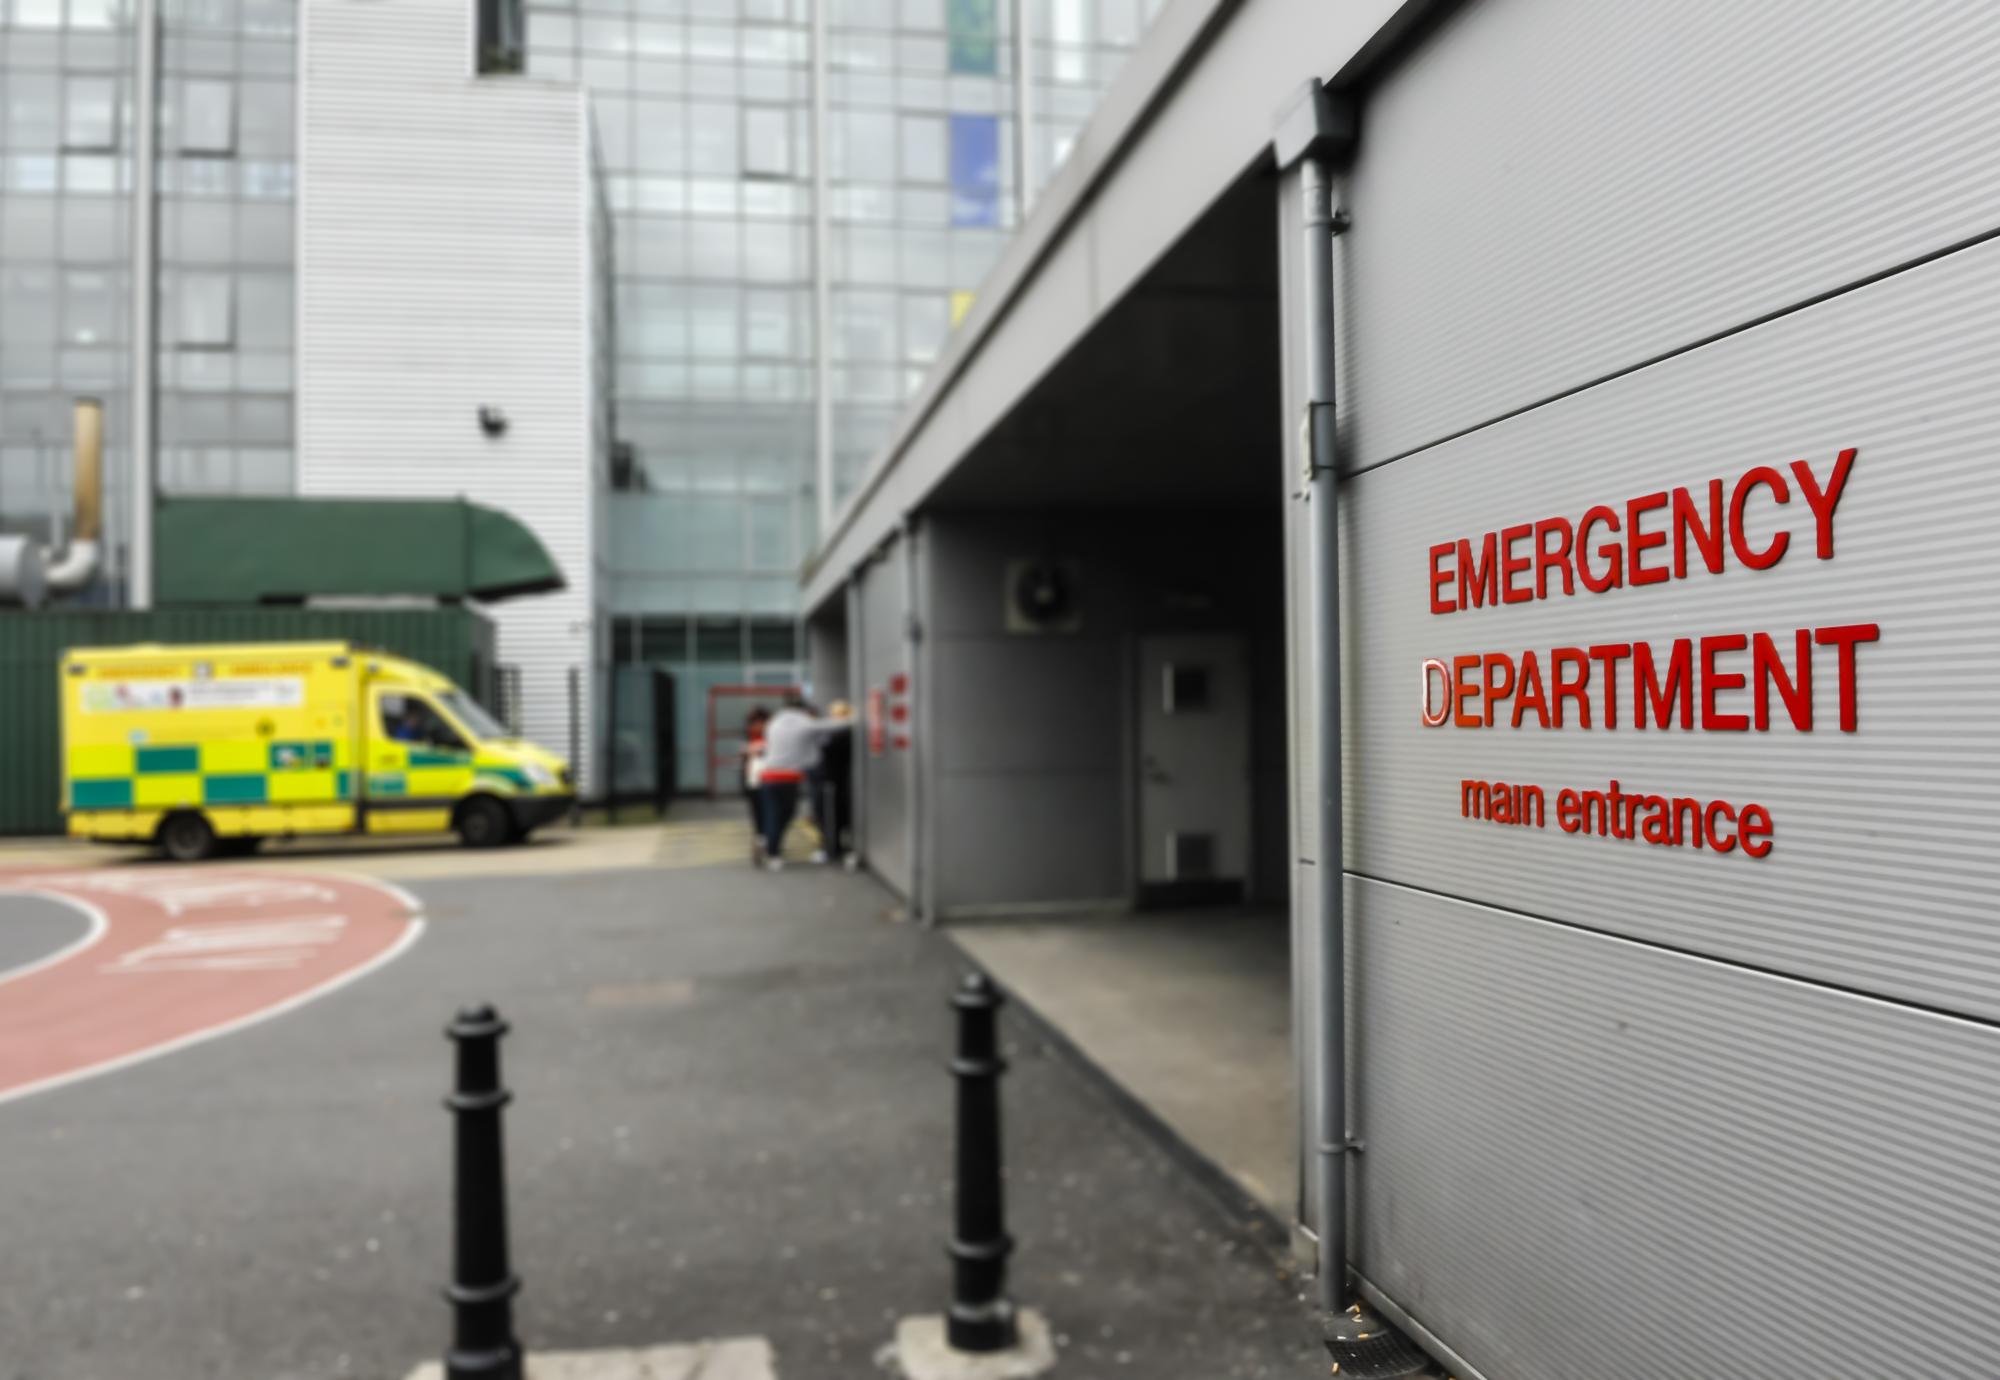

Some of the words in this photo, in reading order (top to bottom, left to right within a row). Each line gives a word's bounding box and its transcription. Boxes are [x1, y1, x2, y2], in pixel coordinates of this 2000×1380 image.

[1429, 447, 1857, 614] EMERGENCY
[1422, 623, 1879, 732] DEPARTMENT
[1460, 779, 1545, 828] main
[1556, 779, 1773, 858] entrance
